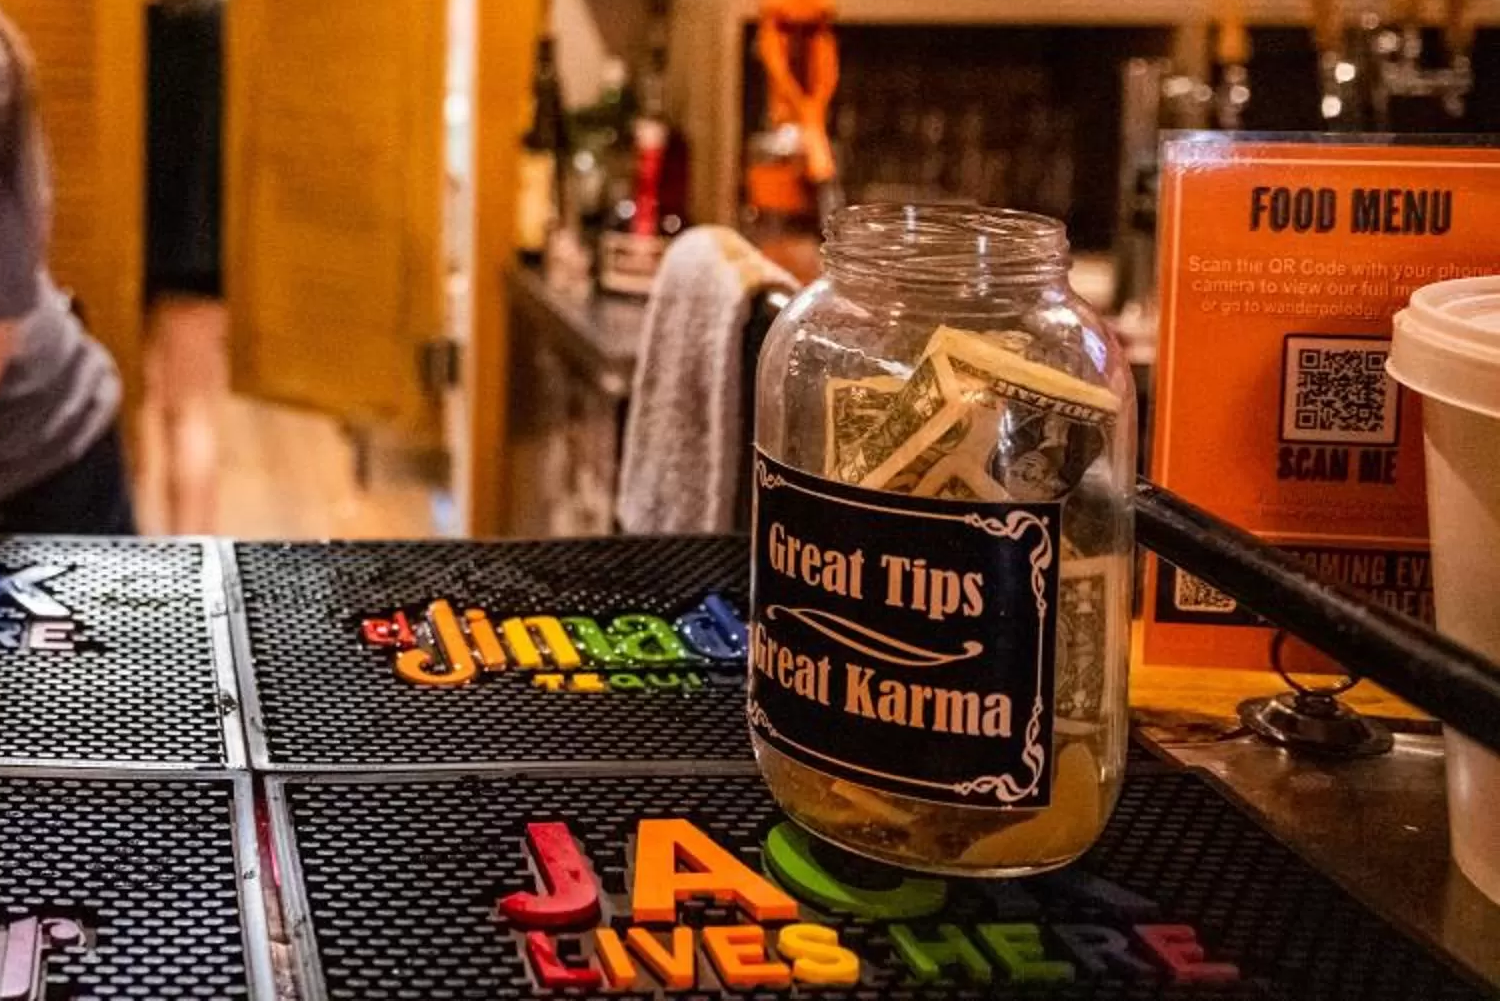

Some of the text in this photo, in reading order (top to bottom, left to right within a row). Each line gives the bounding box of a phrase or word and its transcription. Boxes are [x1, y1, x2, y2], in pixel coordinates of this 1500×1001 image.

[1250, 186, 1453, 236] FOOD MENU
[1188, 255, 1232, 273] Scan
[1236, 257, 1263, 274] the
[1268, 257, 1297, 275] QR
[1300, 259, 1347, 277] Code
[1351, 261, 1388, 278] with
[1392, 264, 1433, 281] your
[1191, 277, 1255, 293] camera
[1259, 277, 1279, 295] to
[1282, 279, 1323, 297] view
[1326, 281, 1357, 297] our
[1361, 279, 1389, 297] full
[1200, 299, 1218, 313] or
[1221, 301, 1241, 317] go
[1243, 299, 1261, 314] to
[1276, 446, 1398, 484] SCAN ME
[768, 521, 985, 620] Great Tips
[361, 593, 749, 686] el Jimad
[753, 622, 1013, 739] Great Karma
[525, 921, 1240, 990] LIVES HERE
